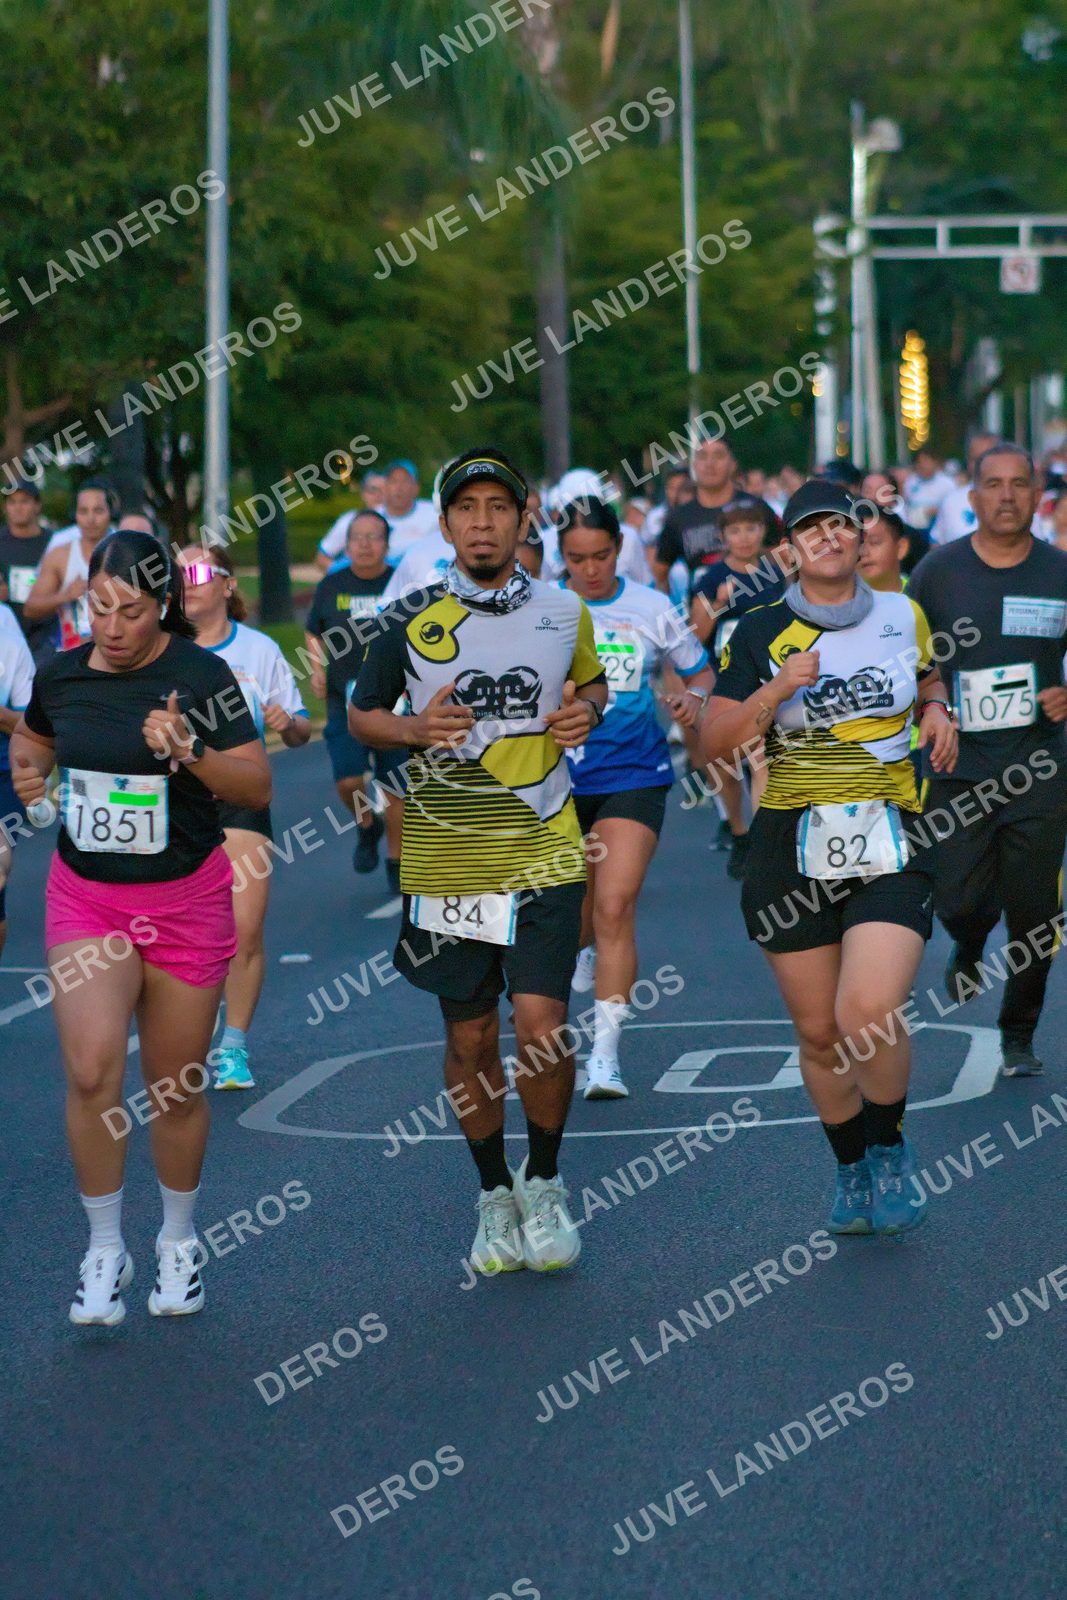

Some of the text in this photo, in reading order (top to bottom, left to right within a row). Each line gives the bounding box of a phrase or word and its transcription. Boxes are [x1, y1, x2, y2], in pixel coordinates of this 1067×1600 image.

[476, 685, 521, 696] RINOS
[964, 689, 1034, 723] 1075
[75, 804, 154, 844] 1851
[827, 833, 871, 868] 82
[442, 896, 484, 929] 84
